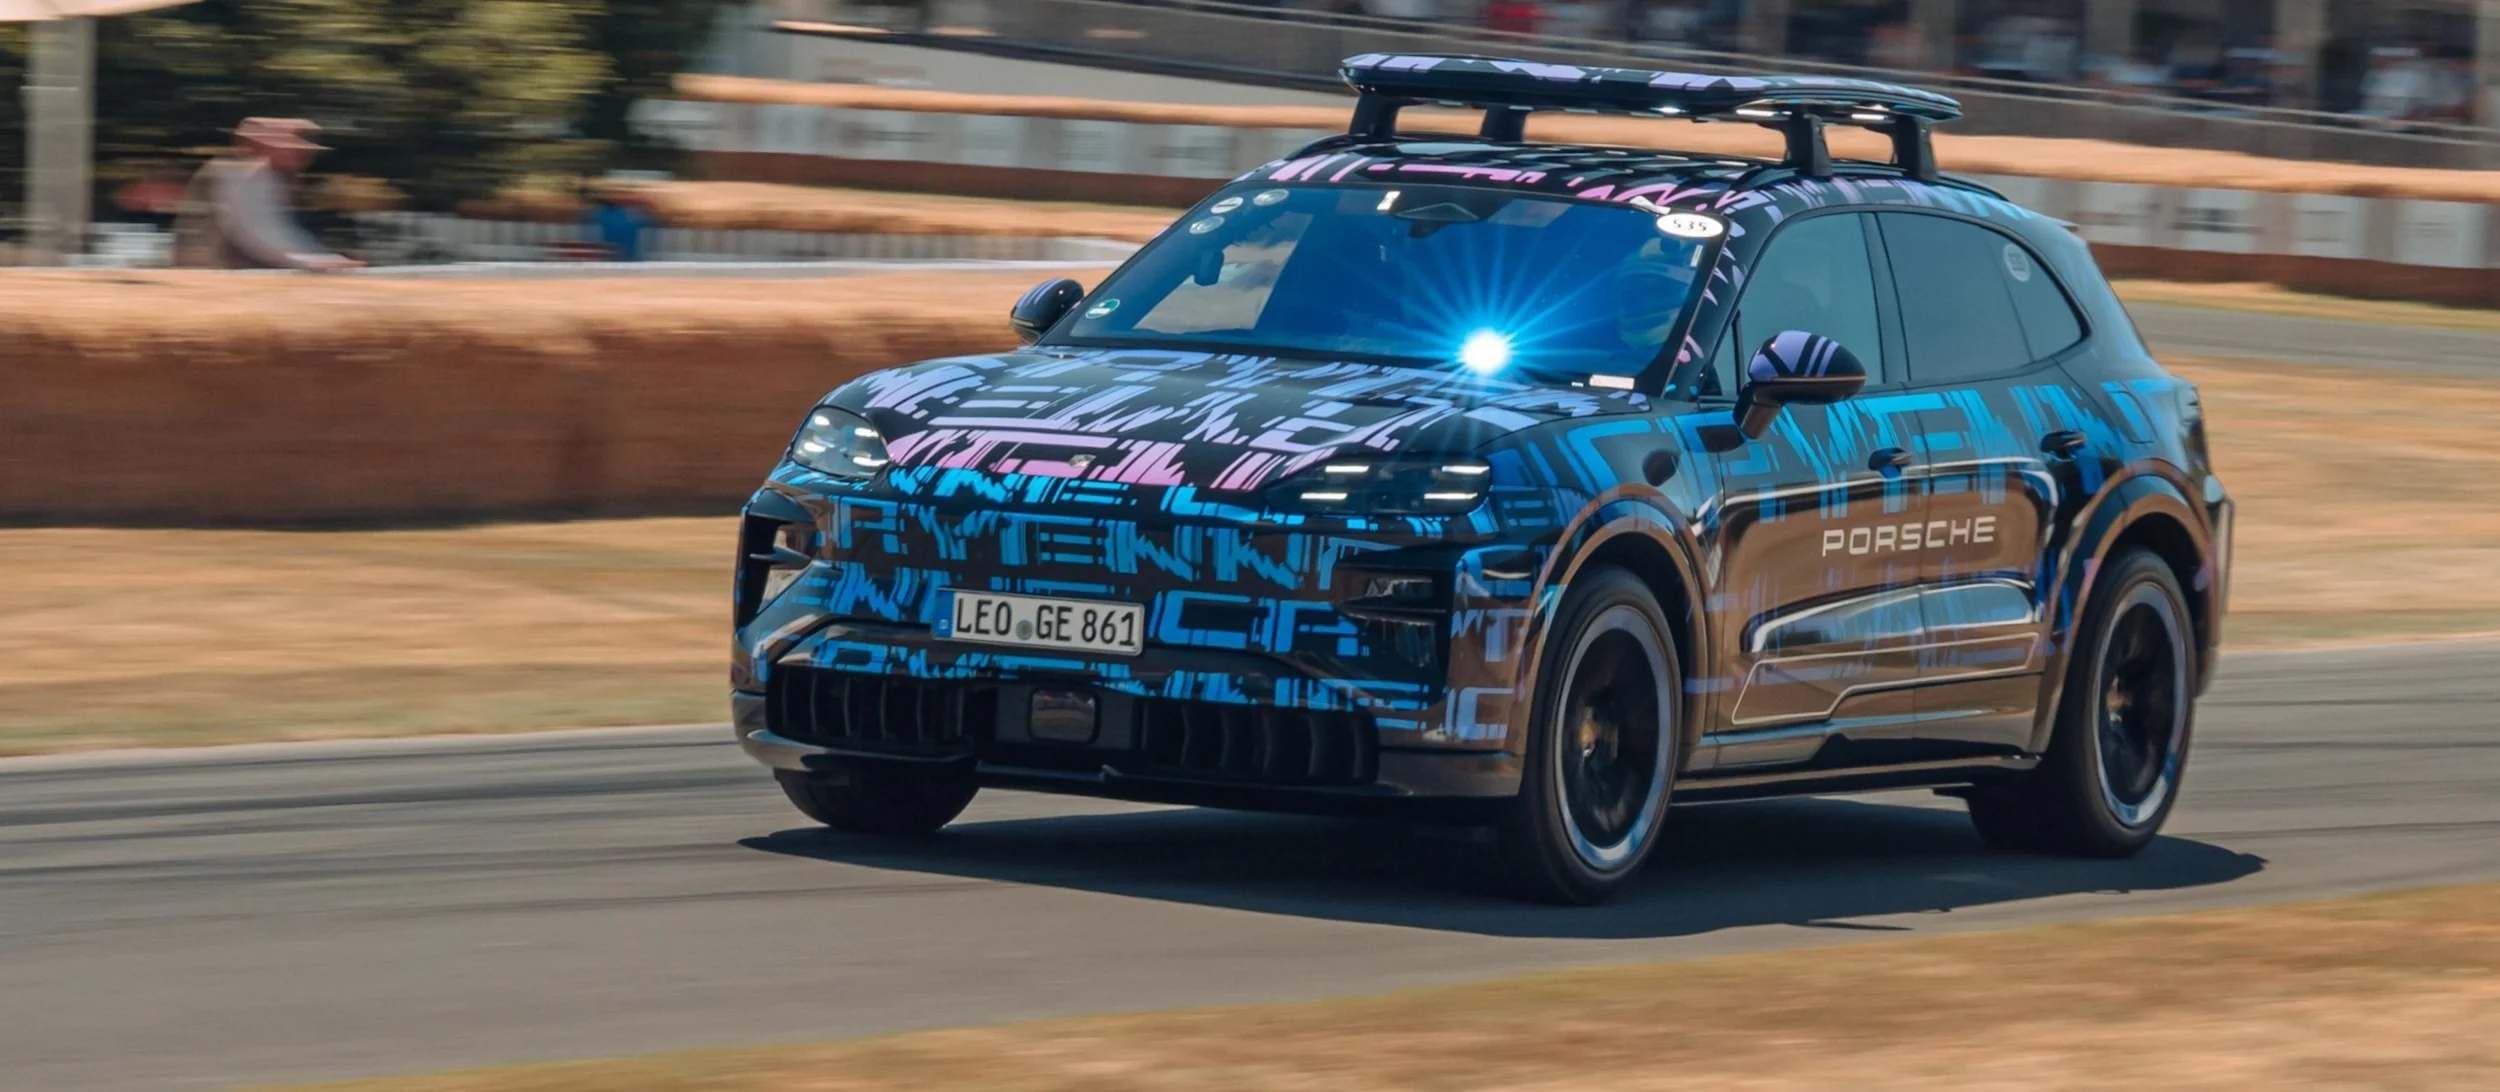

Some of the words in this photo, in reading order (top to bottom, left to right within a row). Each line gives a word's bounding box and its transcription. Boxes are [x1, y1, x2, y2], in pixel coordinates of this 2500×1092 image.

[1822, 516, 1996, 557] PORSCHE
[956, 598, 1012, 636] LEO
[1036, 604, 1073, 642] GE
[1081, 609, 1135, 647] 861
